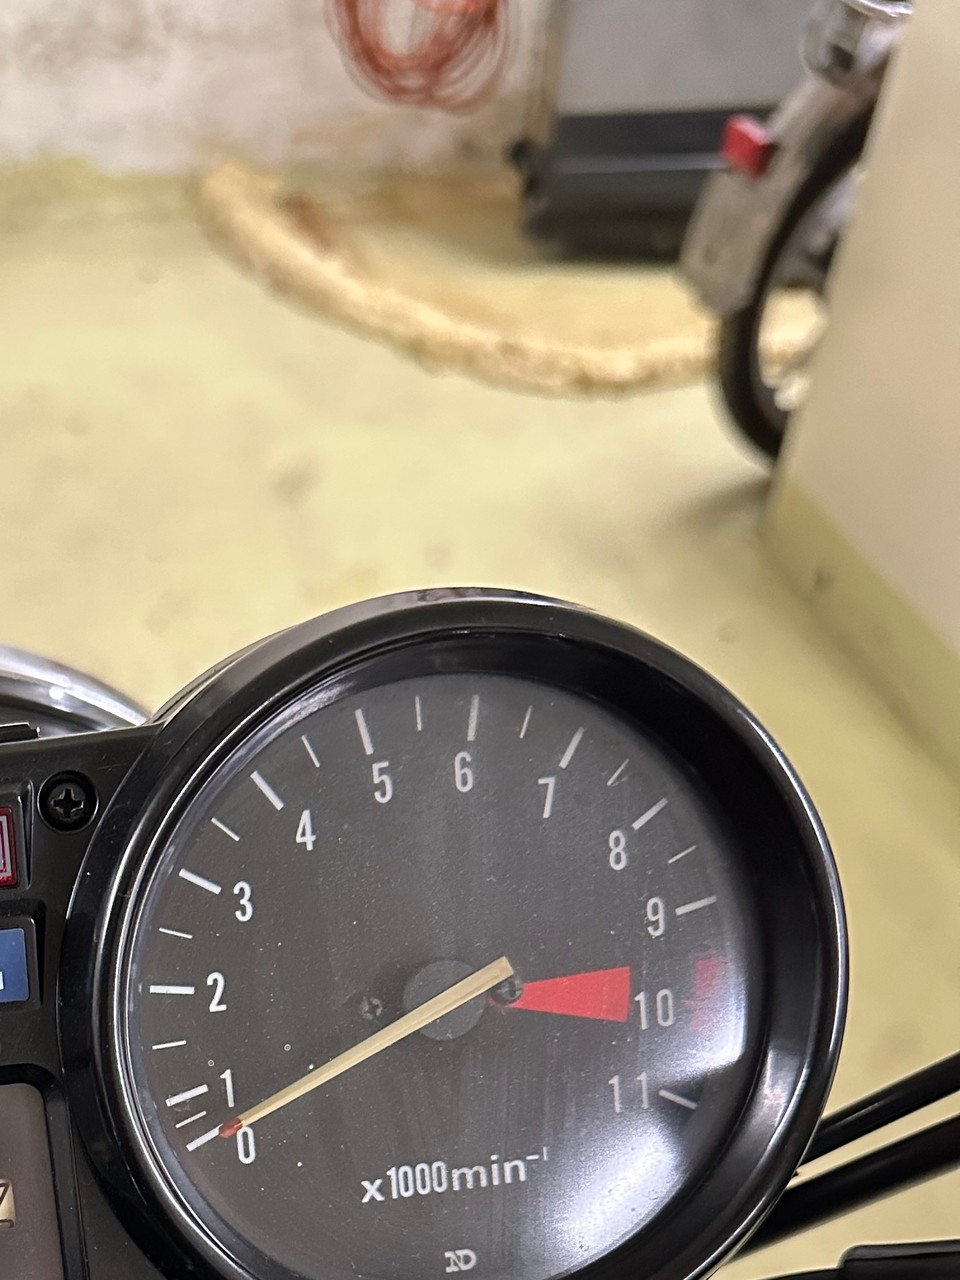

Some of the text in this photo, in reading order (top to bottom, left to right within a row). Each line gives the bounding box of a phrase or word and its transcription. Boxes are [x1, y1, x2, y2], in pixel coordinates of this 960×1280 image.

[371, 760, 394, 804] 5
[453, 751, 475, 793] 6
[536, 776, 557, 819] 7
[294, 809, 318, 851] 4
[607, 829, 629, 871] 8
[232, 880, 254, 922] 3
[644, 896, 667, 939] 9
[205, 971, 228, 1013] 2
[633, 988, 676, 1031] 10
[219, 1068, 235, 1108] 1
[608, 1071, 649, 1114] 11
[235, 1125, 257, 1165] 0
